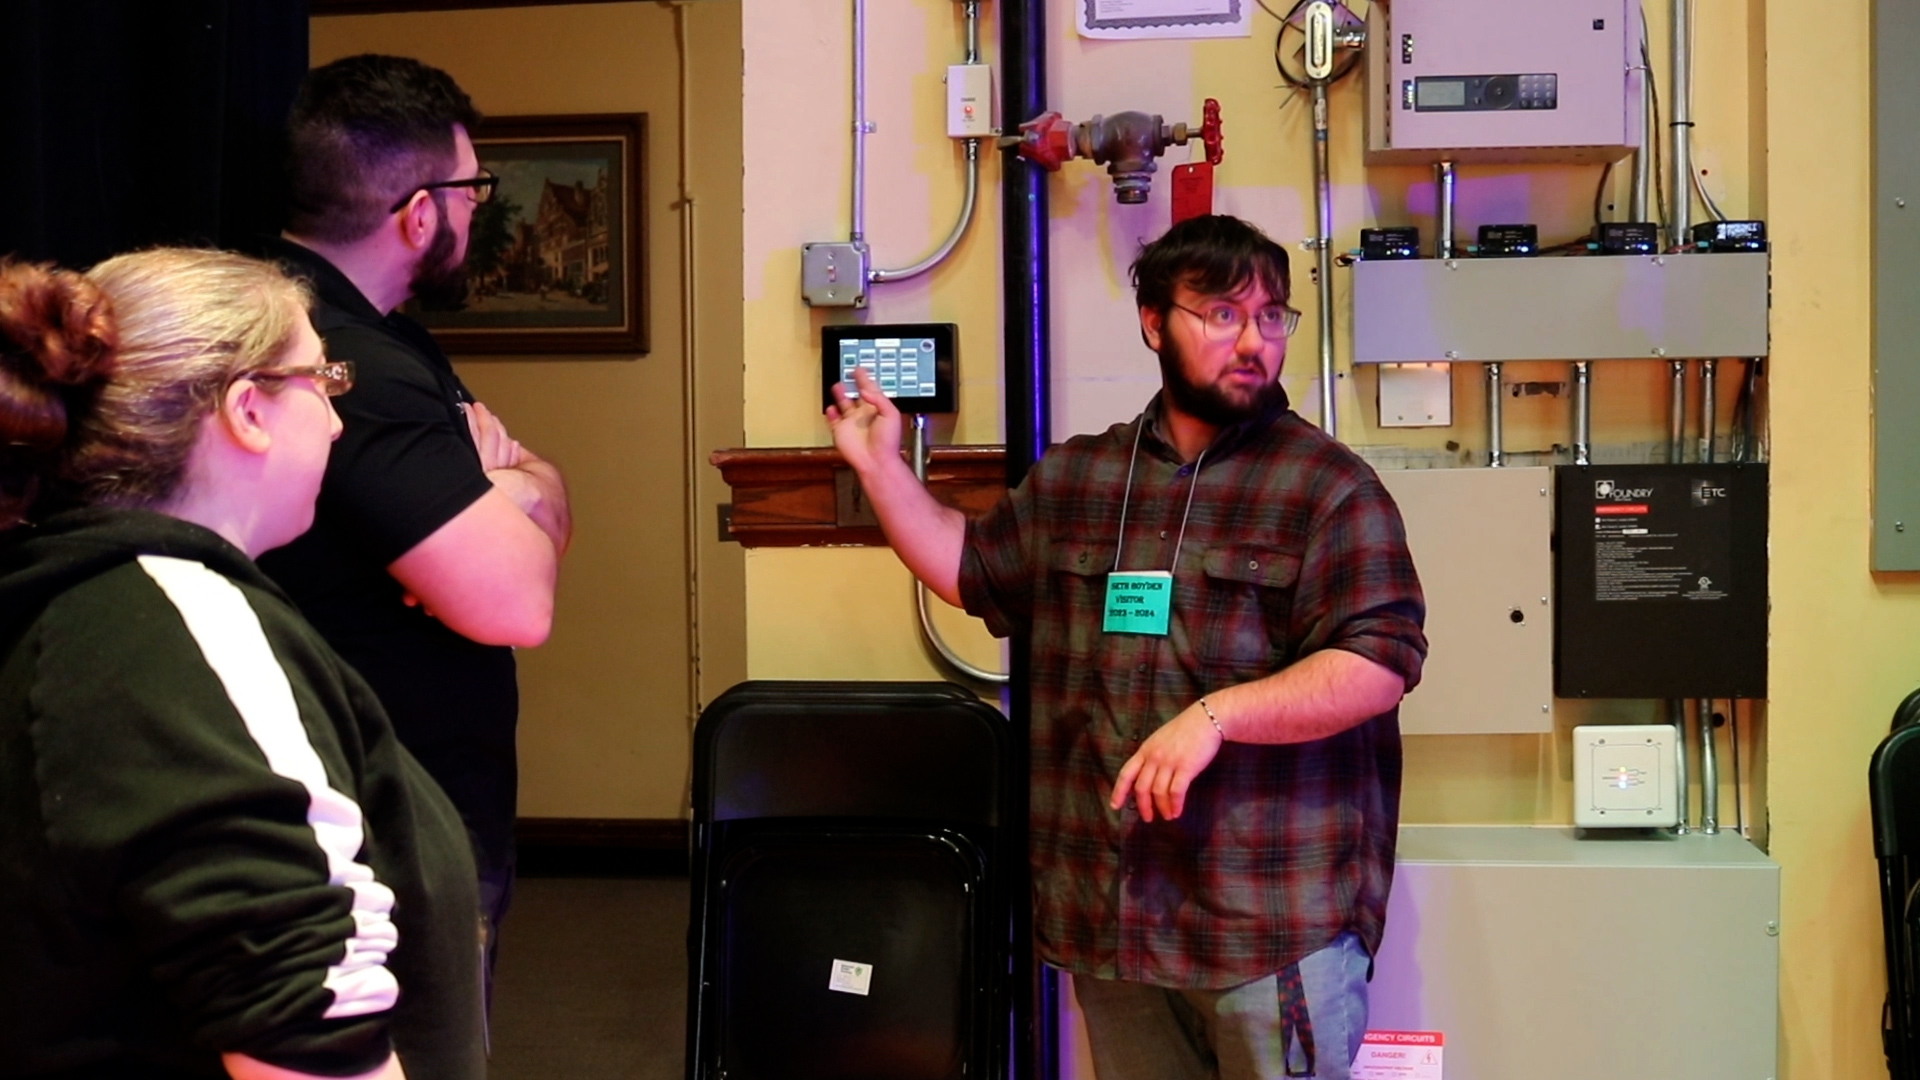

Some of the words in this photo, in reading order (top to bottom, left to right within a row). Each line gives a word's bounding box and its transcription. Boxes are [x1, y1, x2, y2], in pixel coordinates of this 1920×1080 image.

[1703, 488, 1727, 498] ETC
[1116, 595, 1144, 603] VISITOR
[1135, 609, 1154, 617] 2024
[1397, 1034, 1435, 1043] CIRCUITS
